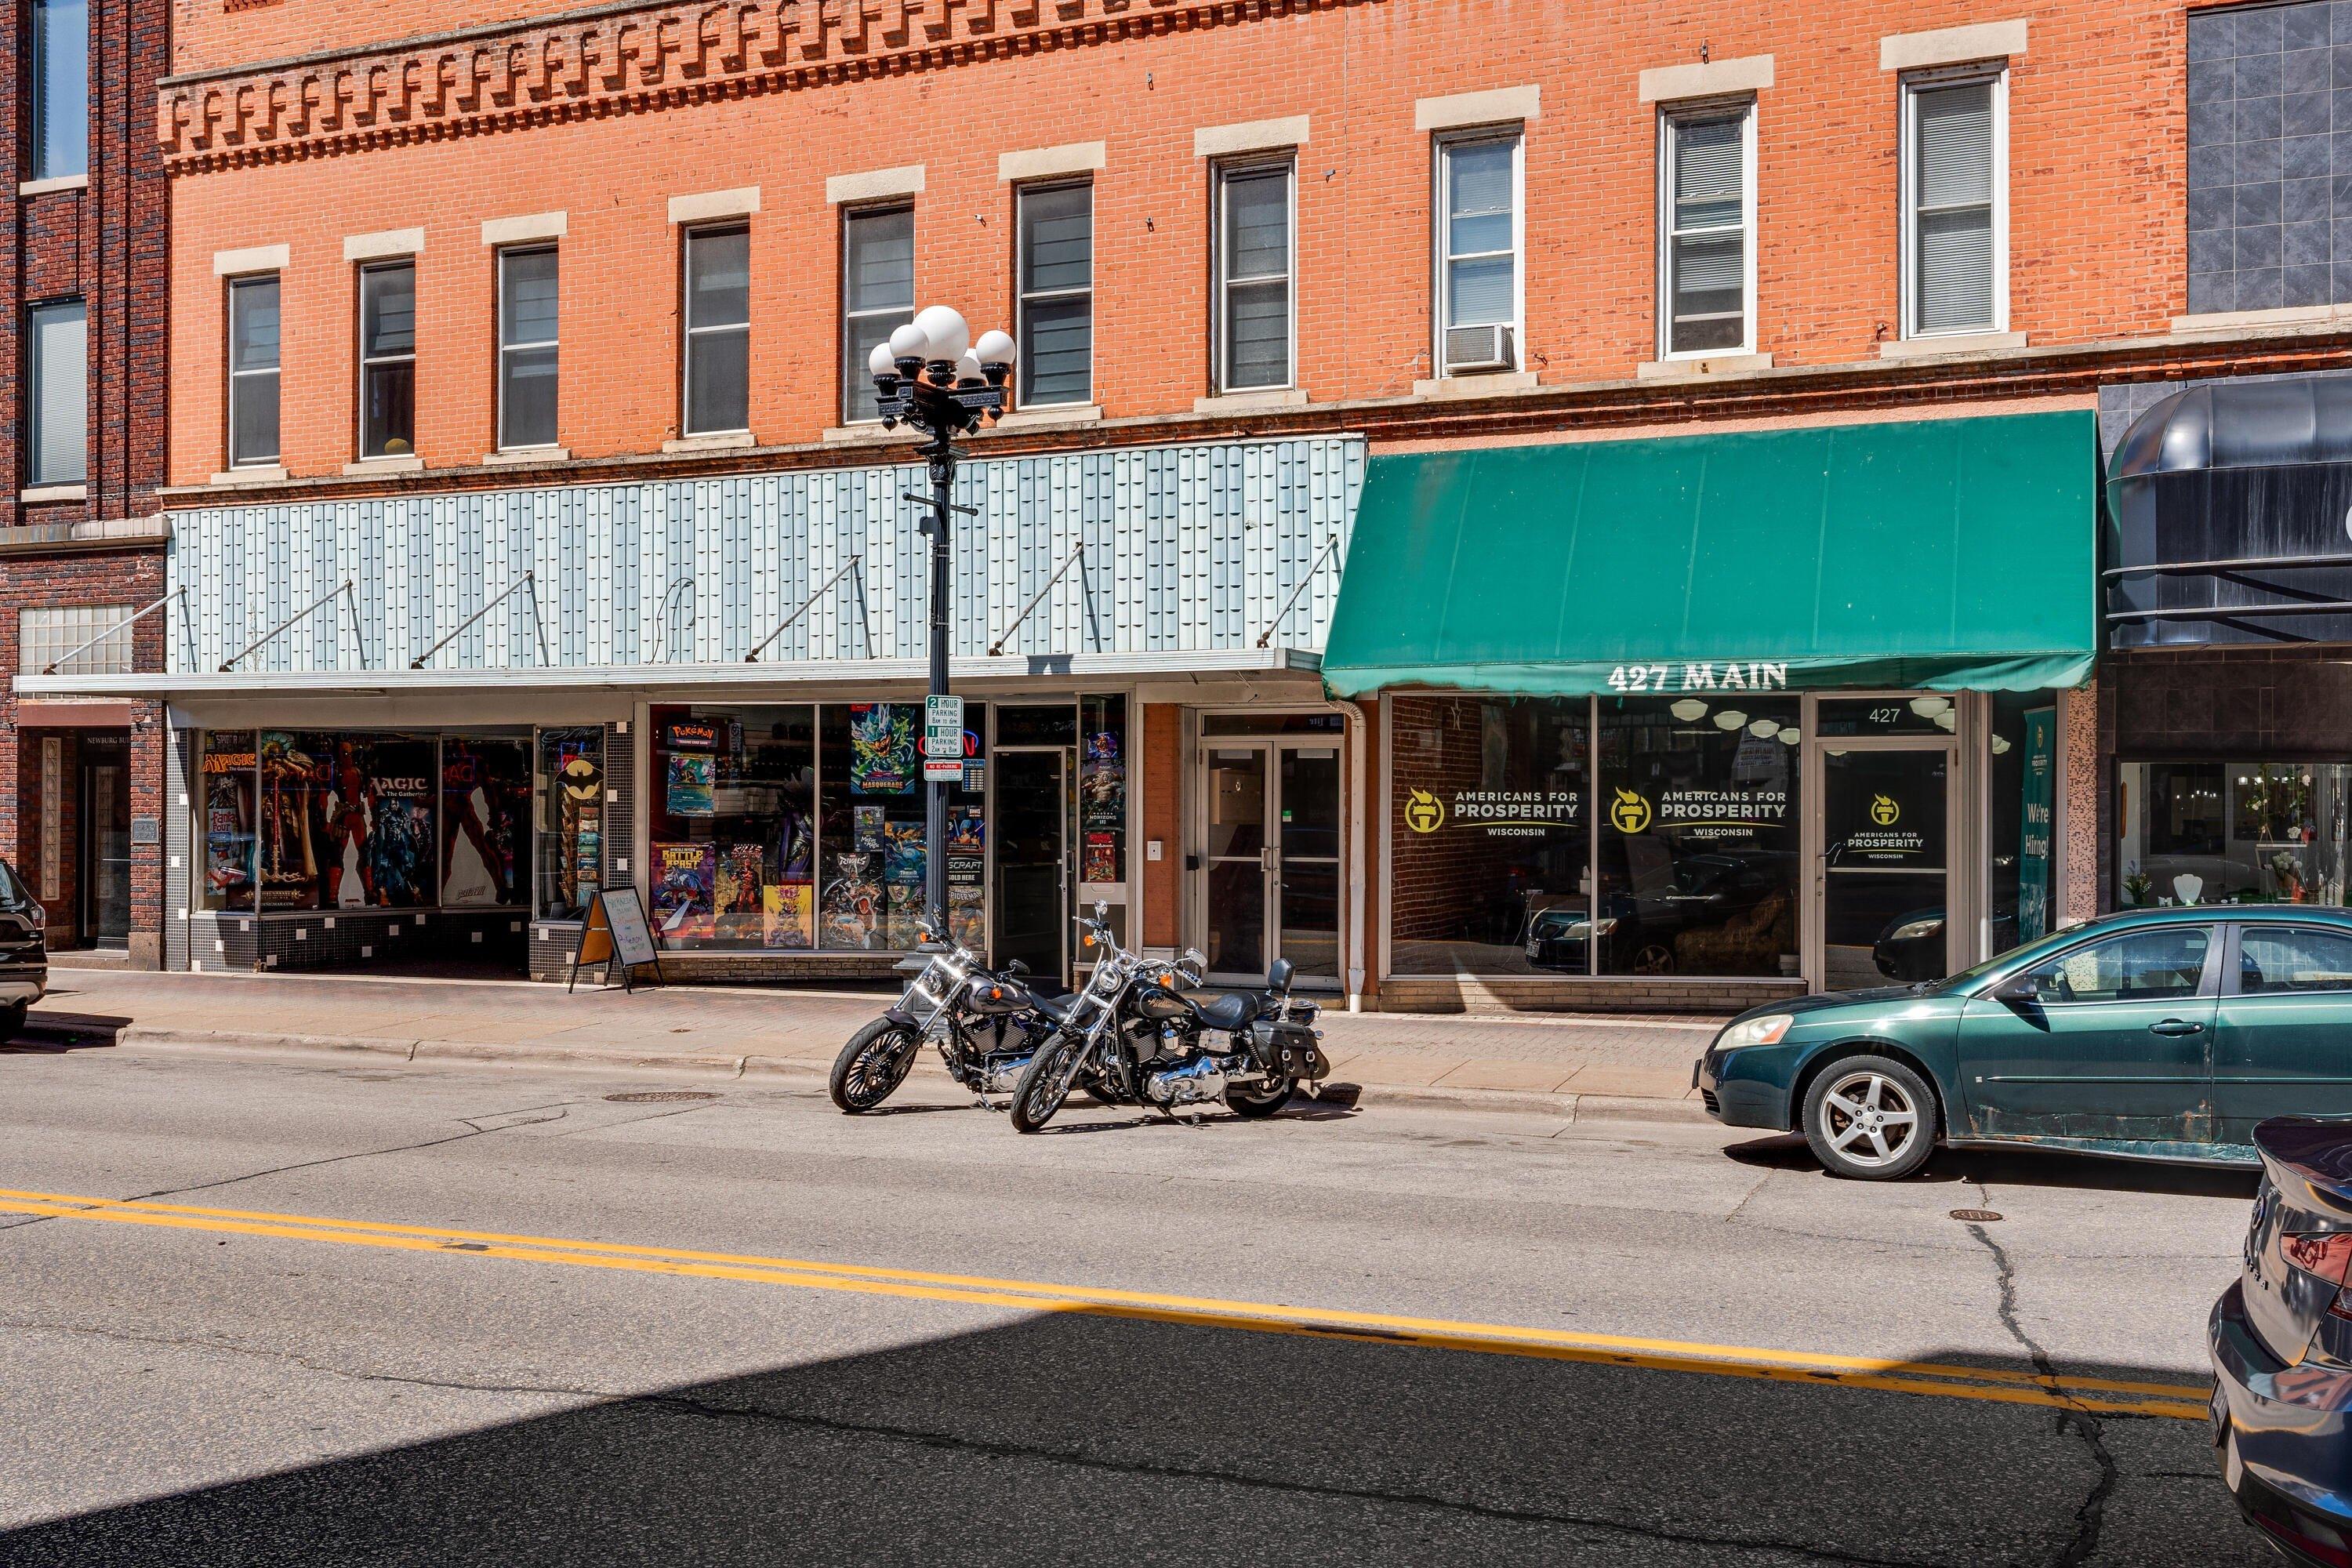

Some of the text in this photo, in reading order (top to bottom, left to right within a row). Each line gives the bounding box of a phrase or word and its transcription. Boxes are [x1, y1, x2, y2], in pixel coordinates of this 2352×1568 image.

[1608, 663, 1788, 691] 427 MAIN
[930, 698, 958, 708] 2 HOUR
[1869, 709, 1900, 723] 427
[941, 728, 958, 737] HOUR
[202, 753, 256, 774] MAGIC
[862, 781, 903, 789] MASQUERADE
[1455, 792, 1577, 801] AMERICANS FOR
[1662, 792, 1786, 801] AMERICANS FOR
[1454, 804, 1578, 818] PROSPERITY
[1661, 804, 1786, 818] PROSPERITY
[1487, 828, 1545, 837] WISCONSIN
[1693, 828, 1753, 837] WISCONSIN
[1848, 839, 1923, 848] PROSPERITY
[662, 850, 703, 860] BATTLE
[666, 860, 701, 869] BEAST
[839, 855, 867, 865] RIVALS
